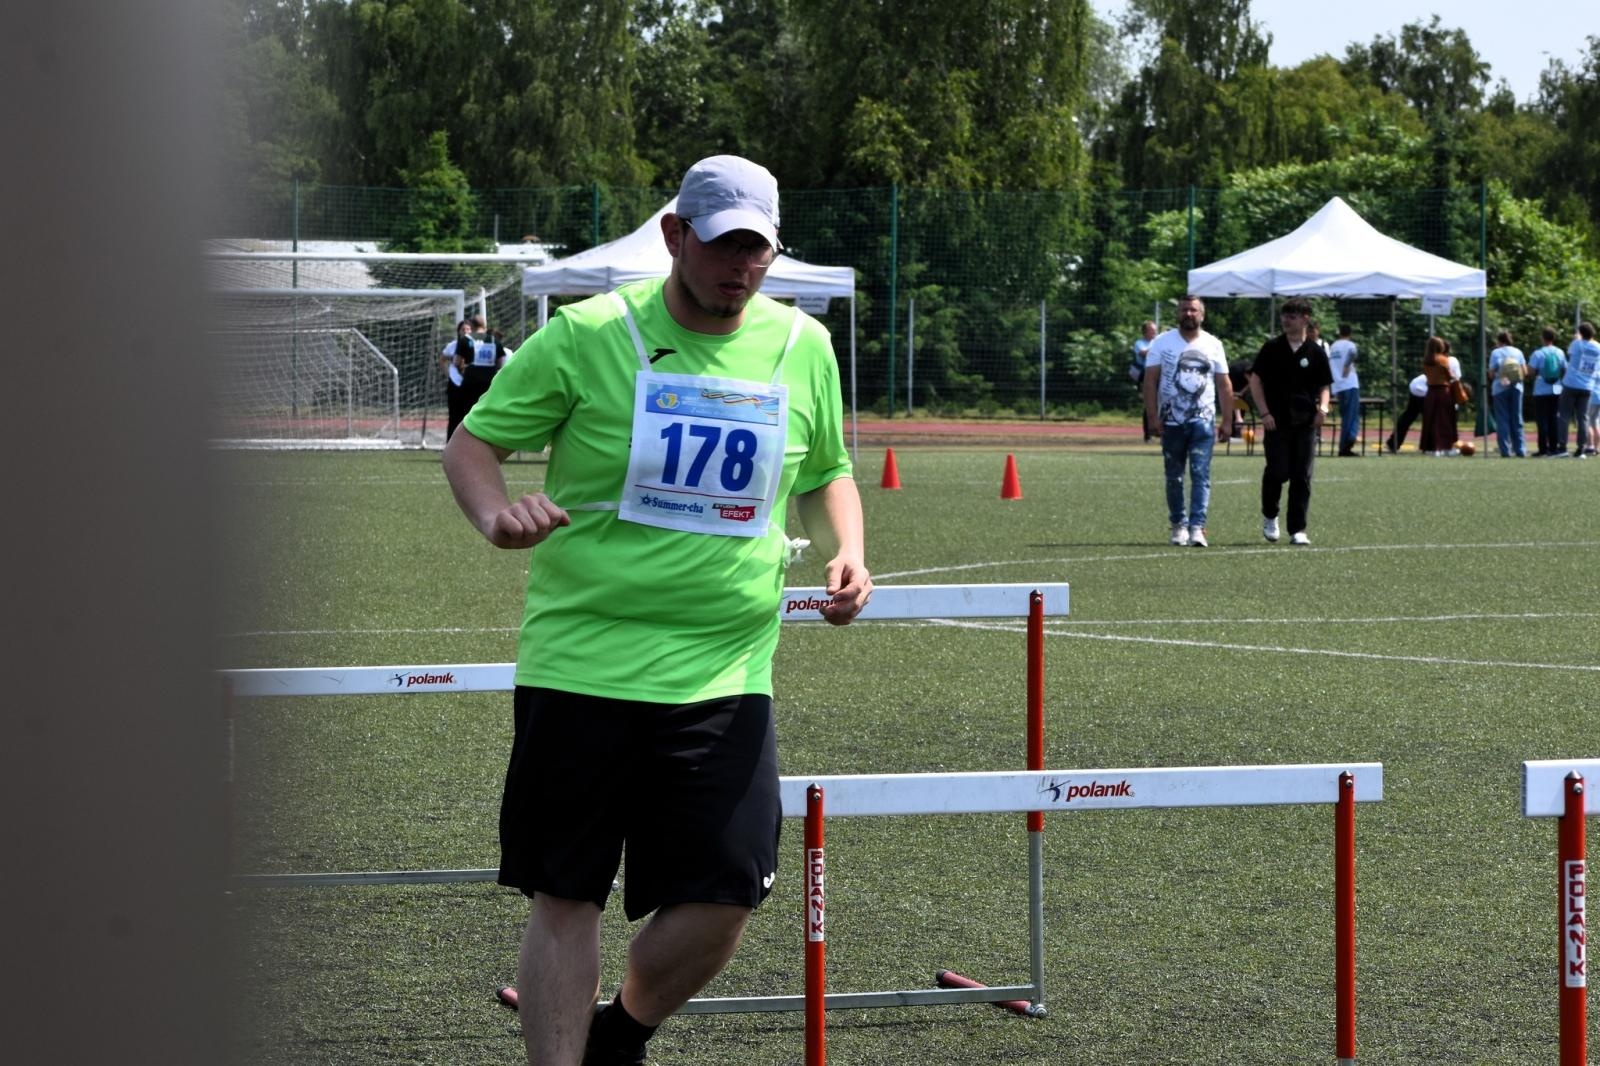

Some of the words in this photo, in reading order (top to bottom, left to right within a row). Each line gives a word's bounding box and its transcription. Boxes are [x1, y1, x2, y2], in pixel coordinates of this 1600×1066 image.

[660, 422, 758, 492] 178
[651, 497, 704, 514] Summer-cha
[722, 510, 751, 518] EFEKT
[786, 596, 835, 613] polan
[407, 672, 454, 687] polanik
[1065, 779, 1132, 802] polanik
[810, 851, 824, 933] POLANIK
[1568, 864, 1585, 976] POLANIK
